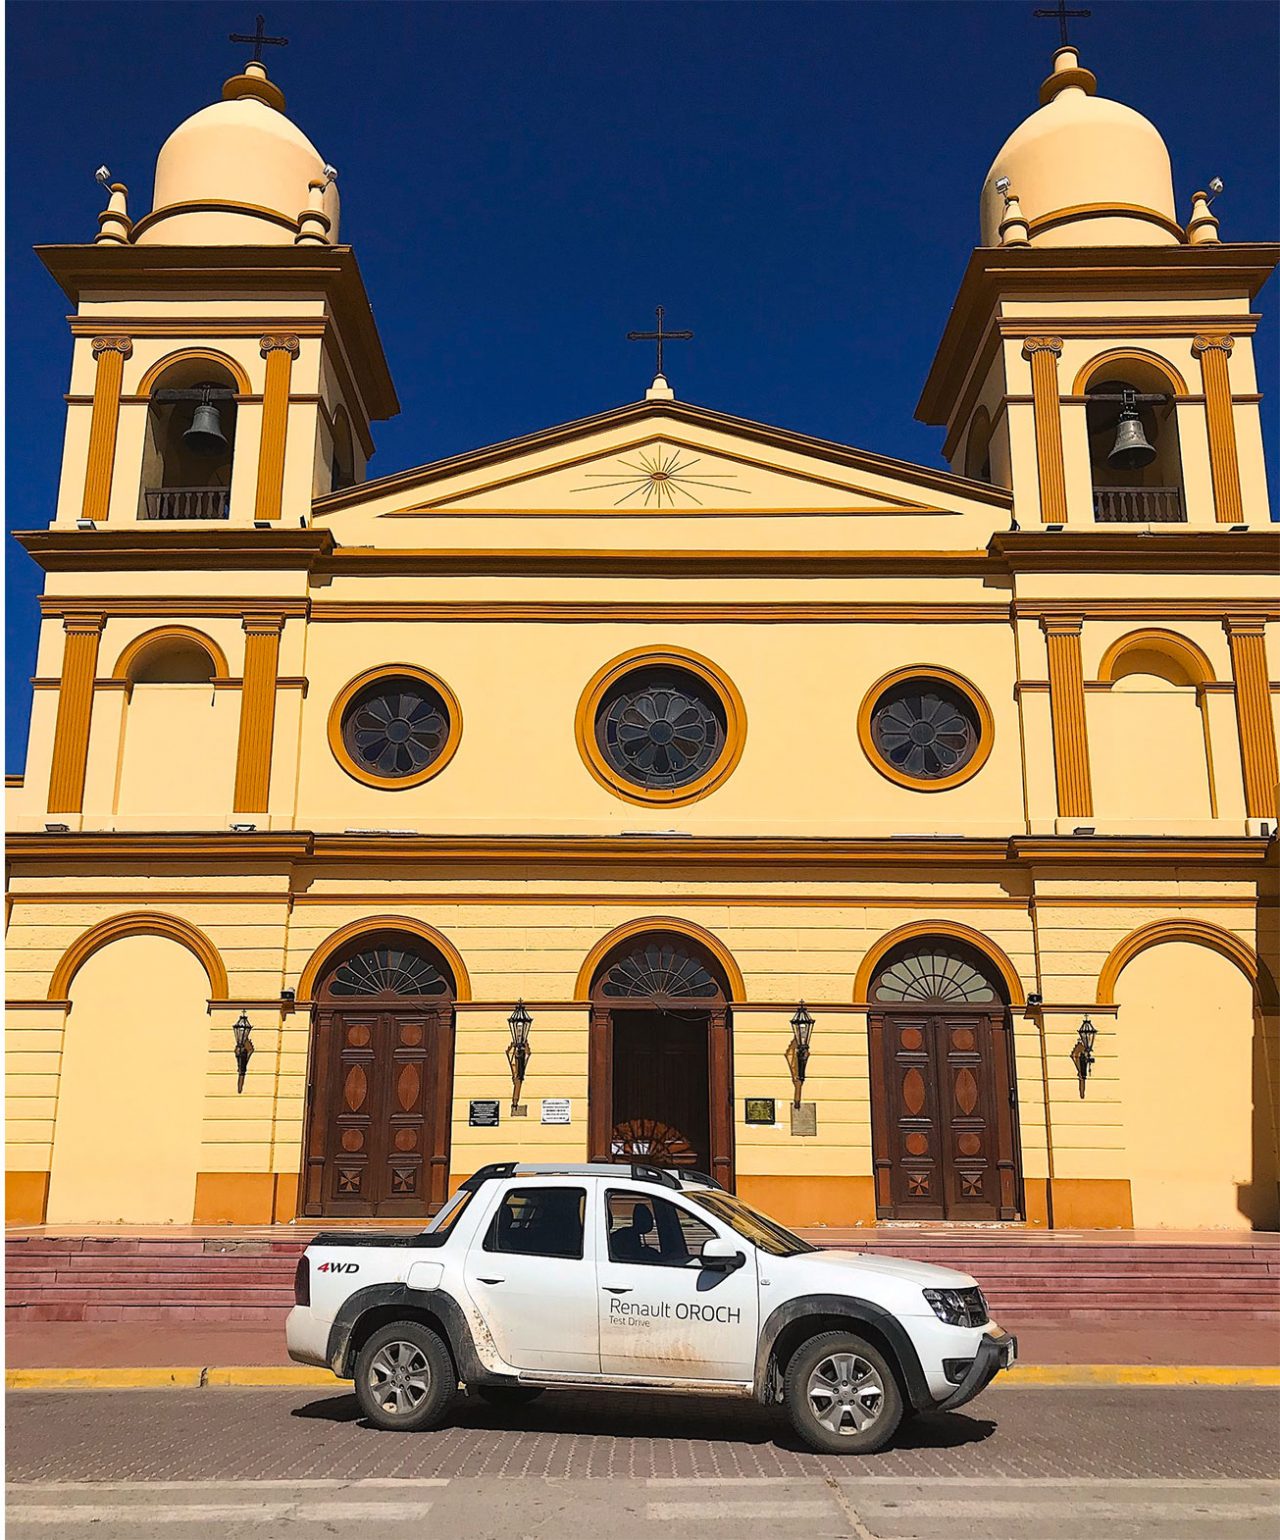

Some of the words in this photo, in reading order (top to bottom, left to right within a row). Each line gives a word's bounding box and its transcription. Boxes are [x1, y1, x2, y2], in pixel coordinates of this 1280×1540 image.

[317, 1262, 360, 1274] 4WD
[609, 1298, 671, 1319] Renault
[675, 1302, 741, 1324] OROCH
[609, 1315, 626, 1326] Test
[628, 1316, 651, 1328] Drive
